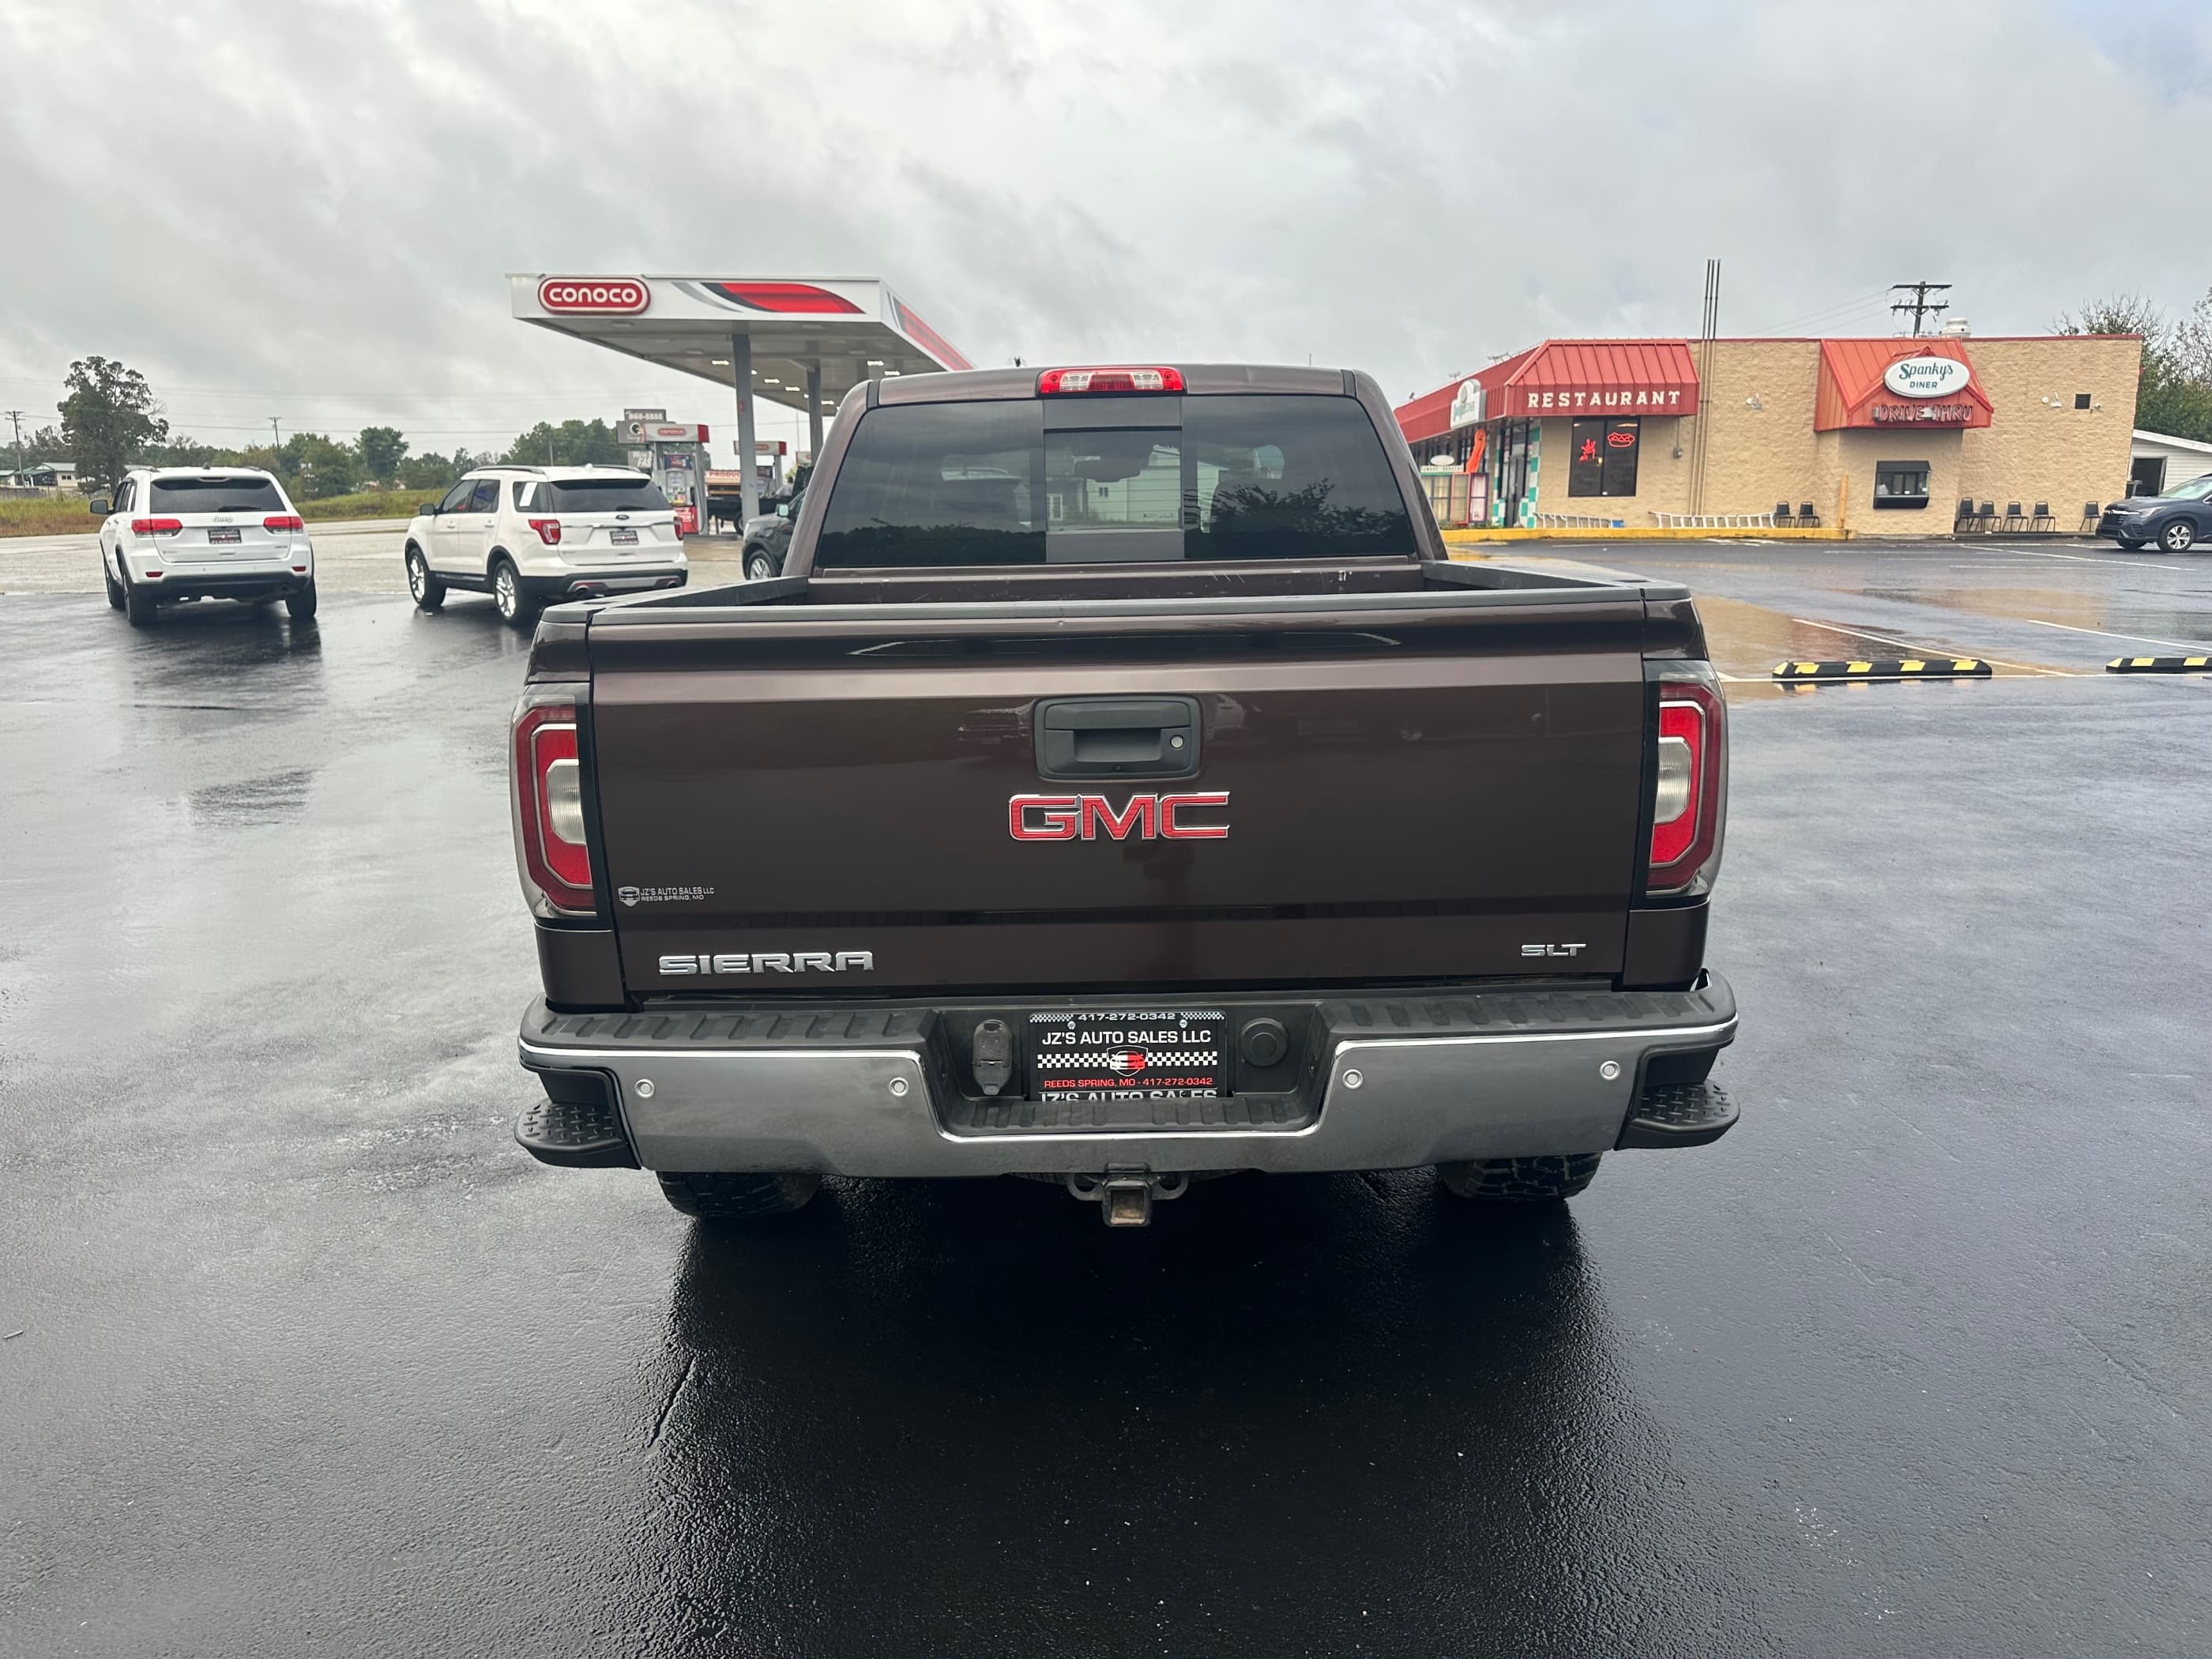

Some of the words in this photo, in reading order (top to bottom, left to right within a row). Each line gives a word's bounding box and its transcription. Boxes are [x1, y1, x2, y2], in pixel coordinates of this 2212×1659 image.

[549, 287, 638, 303] conoco
[1898, 363, 1954, 380] Spanky's
[1909, 381, 1938, 389] DINER
[1527, 390, 1680, 408] RESTAURANT
[1879, 404, 1924, 423] DRIVE
[1932, 404, 1973, 422] THRU
[1009, 791, 1230, 841] GMC
[640, 887, 656, 896] JZ'S
[657, 887, 678, 896] AUTO
[679, 886, 703, 895] SALES
[1521, 943, 1587, 957] SLT
[659, 950, 875, 976] SIERRA
[1078, 1012, 1176, 1021] 417-272-0342
[1041, 1031, 1077, 1045] JZ'S
[1080, 1031, 1124, 1044] AUTO
[1127, 1030, 1178, 1044] SALES
[1182, 1029, 1211, 1044] LLC
[1044, 1079, 1077, 1088] REEDS
[1078, 1078, 1117, 1088] SPRING,
[1119, 1078, 1136, 1087] MO
[1142, 1077, 1213, 1086] 417-272-0342
